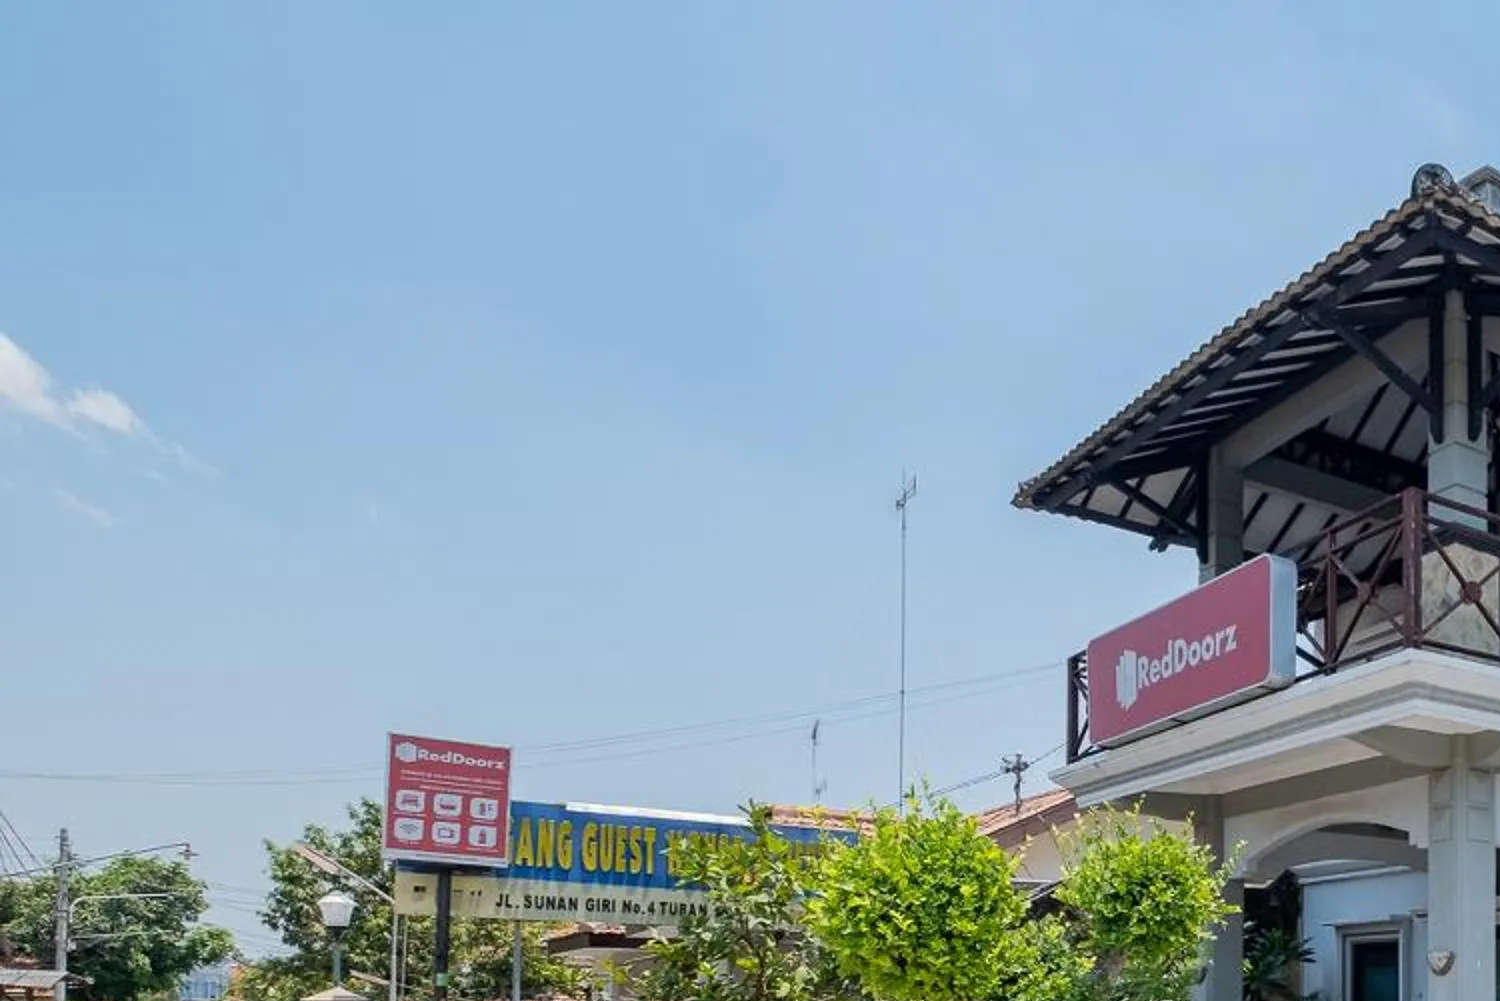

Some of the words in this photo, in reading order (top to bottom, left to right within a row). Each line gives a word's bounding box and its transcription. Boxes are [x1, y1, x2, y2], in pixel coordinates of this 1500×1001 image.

[1137, 623, 1237, 689] RedDoorz
[418, 748, 505, 769] RedDoorz
[511, 815, 573, 871] ANG
[581, 821, 656, 875] GUEST
[495, 893, 520, 909] JL.
[523, 895, 578, 912] SUNAN
[585, 897, 616, 914] GIRI
